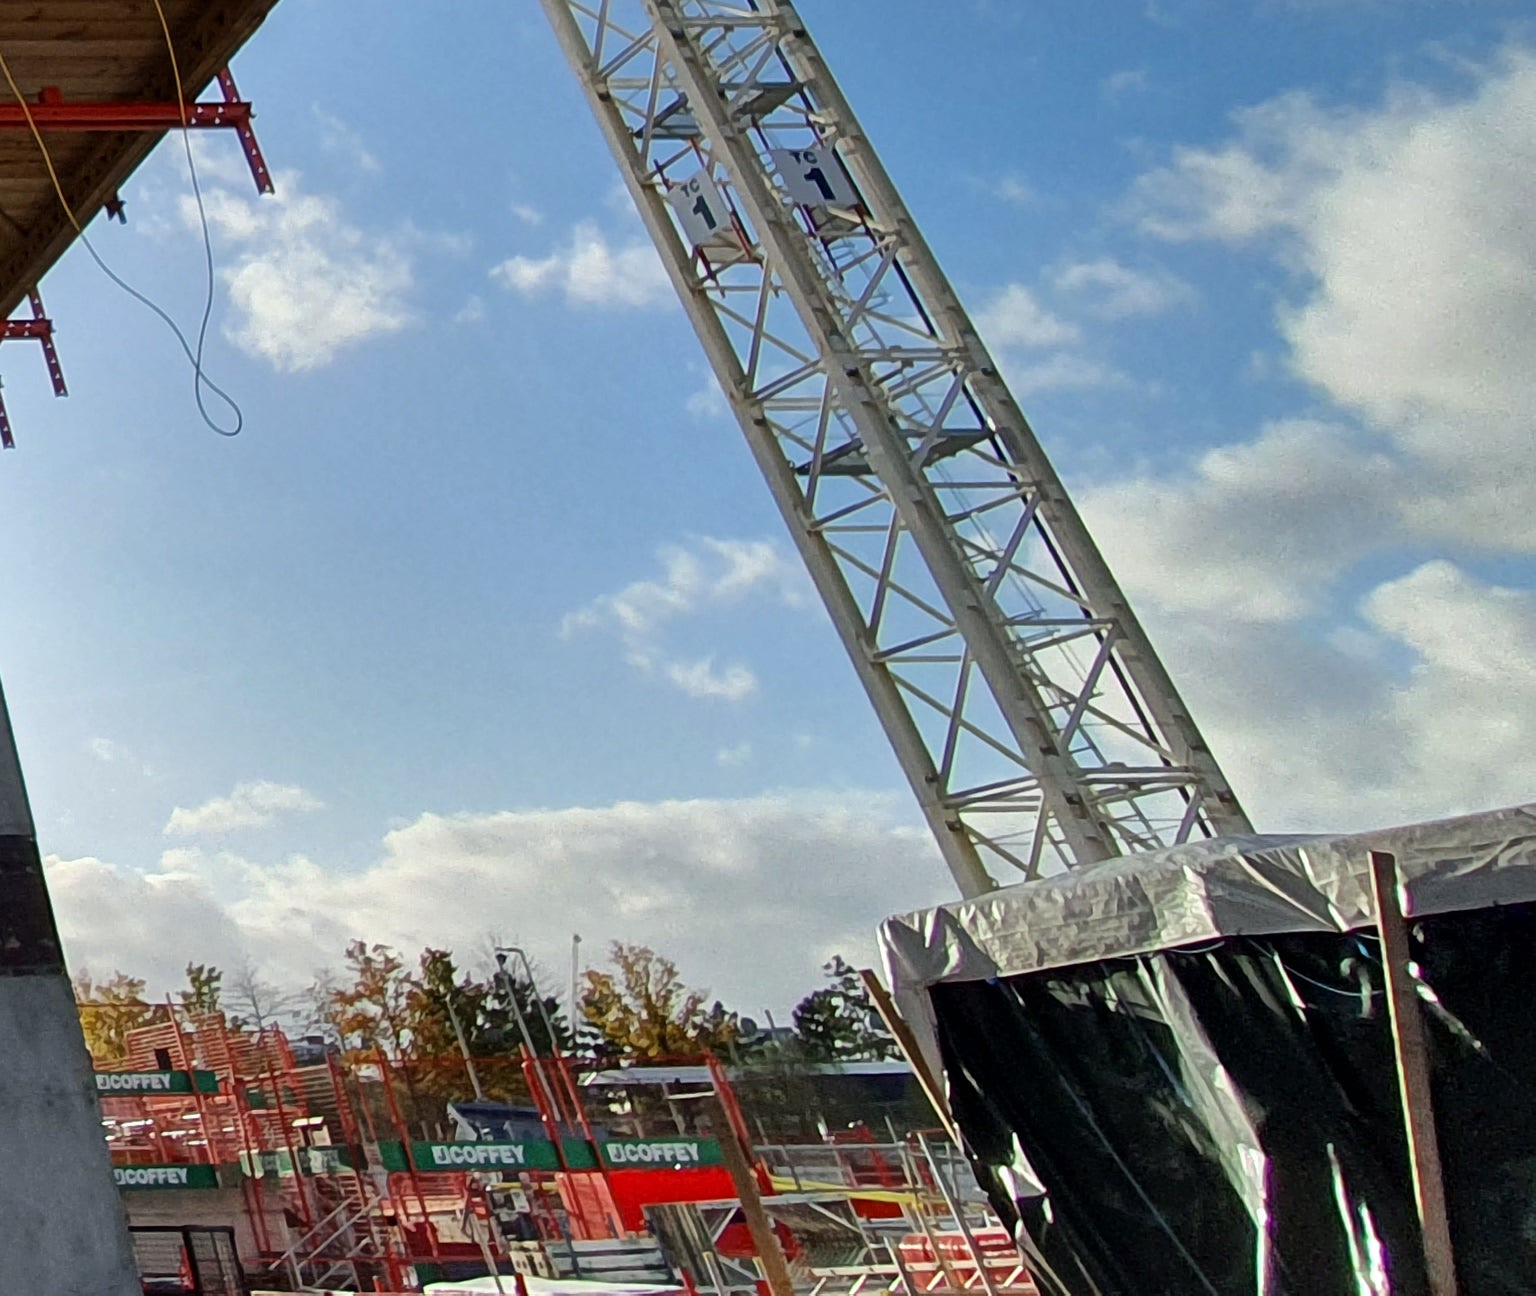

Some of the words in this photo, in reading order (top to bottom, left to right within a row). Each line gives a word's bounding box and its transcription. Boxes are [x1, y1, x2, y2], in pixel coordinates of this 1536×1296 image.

[790, 151, 818, 164] TC
[680, 178, 700, 197] TC
[804, 167, 836, 200] 1
[692, 195, 717, 230] 1
[109, 1073, 170, 1089] COFFEY
[451, 1144, 524, 1164] COFFEY
[623, 1143, 699, 1162] COFFEY
[124, 1167, 187, 1185] COFFEY
